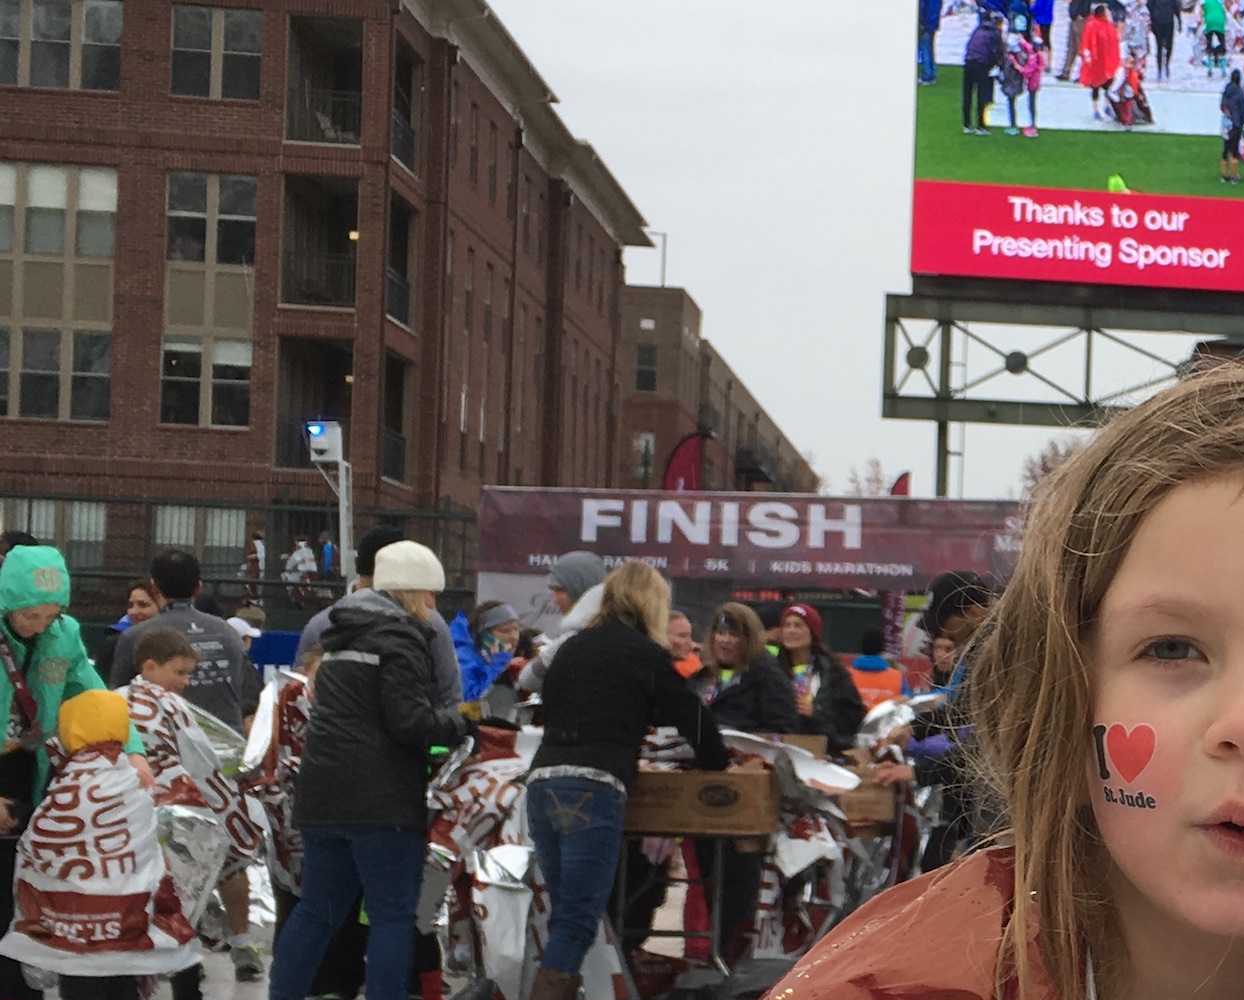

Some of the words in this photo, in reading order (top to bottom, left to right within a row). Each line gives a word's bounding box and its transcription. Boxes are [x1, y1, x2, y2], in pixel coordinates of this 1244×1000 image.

[1008, 195, 1104, 227] Thanks
[1111, 203, 1138, 229] to
[1144, 209, 1190, 232] our
[972, 228, 1113, 268] Presenting
[1118, 236, 1231, 270] Sponsor
[580, 498, 863, 550] FINISH
[769, 560, 813, 574] KIDS
[817, 561, 914, 578] MARATHON
[1093, 724, 1111, 781] I
[1103, 785, 1119, 804] St.
[1119, 788, 1158, 810] Jude
[86, 783, 137, 880] JUDE
